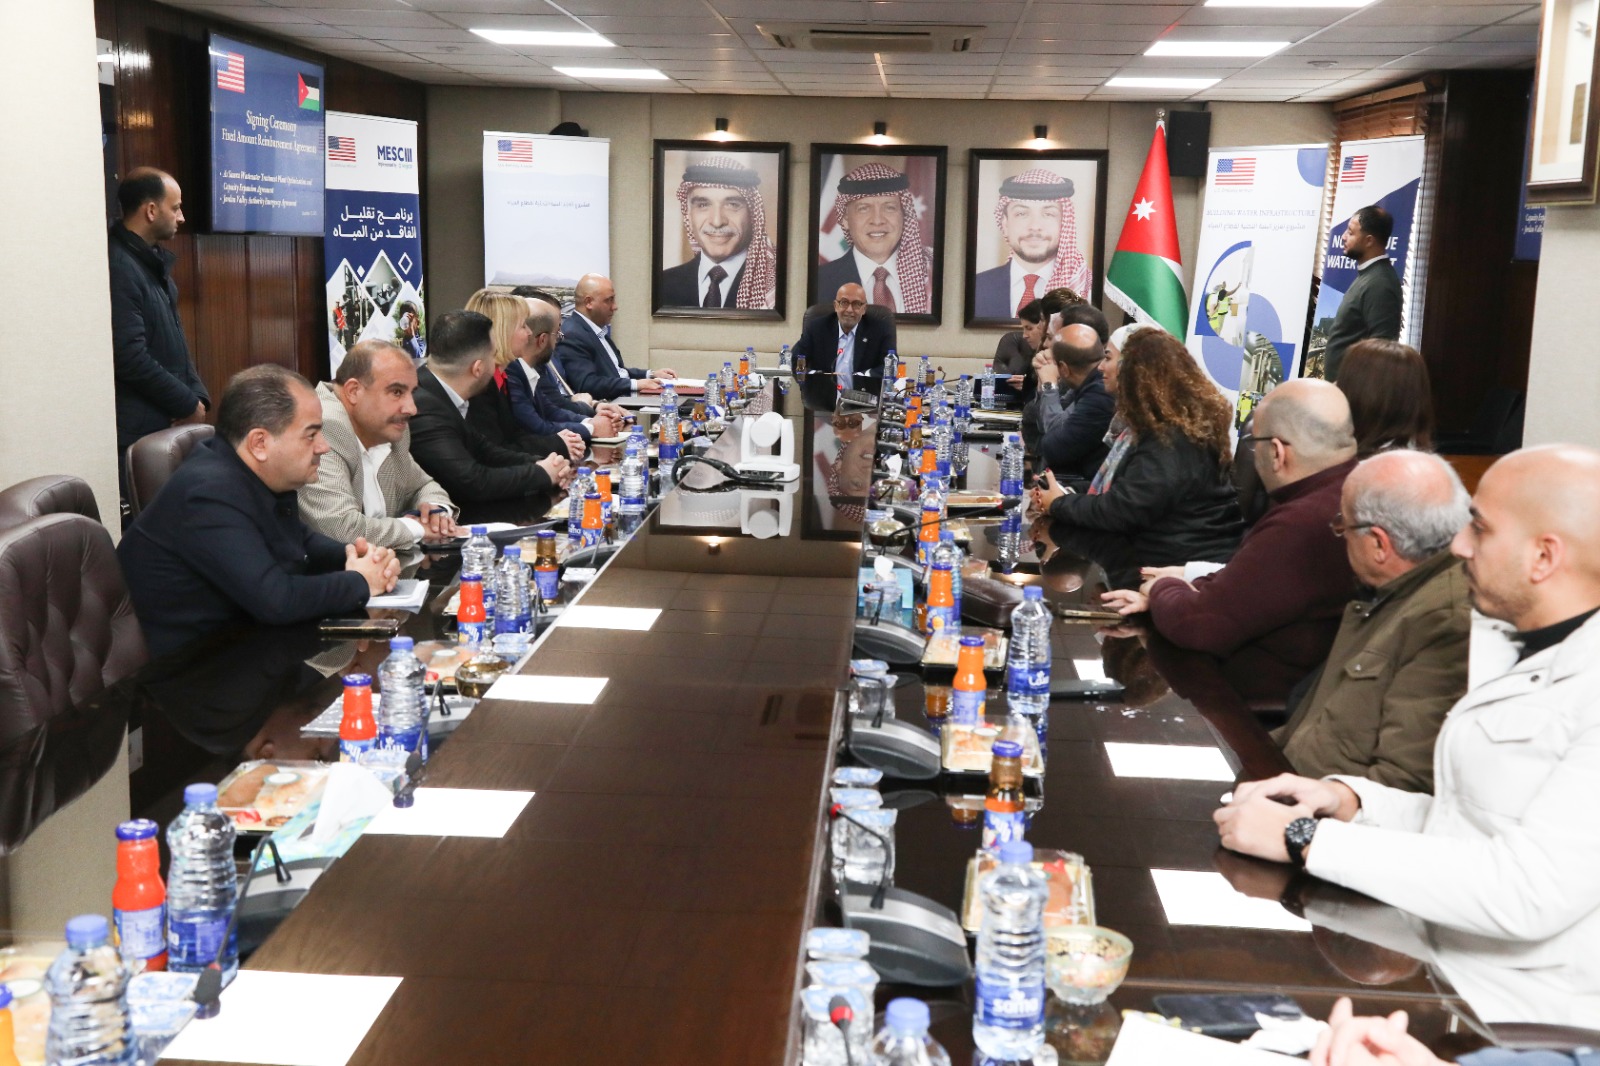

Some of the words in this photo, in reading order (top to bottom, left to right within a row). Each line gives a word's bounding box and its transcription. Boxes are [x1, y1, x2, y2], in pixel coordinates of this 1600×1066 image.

[246, 110, 269, 133] Signing
[269, 114, 297, 137] Ceremony
[222, 128, 236, 142] Fixed
[237, 131, 257, 145] Amount
[341, 205, 375, 222] تقليل
[377, 207, 413, 225] برنامج
[333, 224, 368, 241] المياه
[370, 228, 384, 241] من
[385, 225, 417, 239] الفاقد
[1327, 255, 1357, 270] WATER
